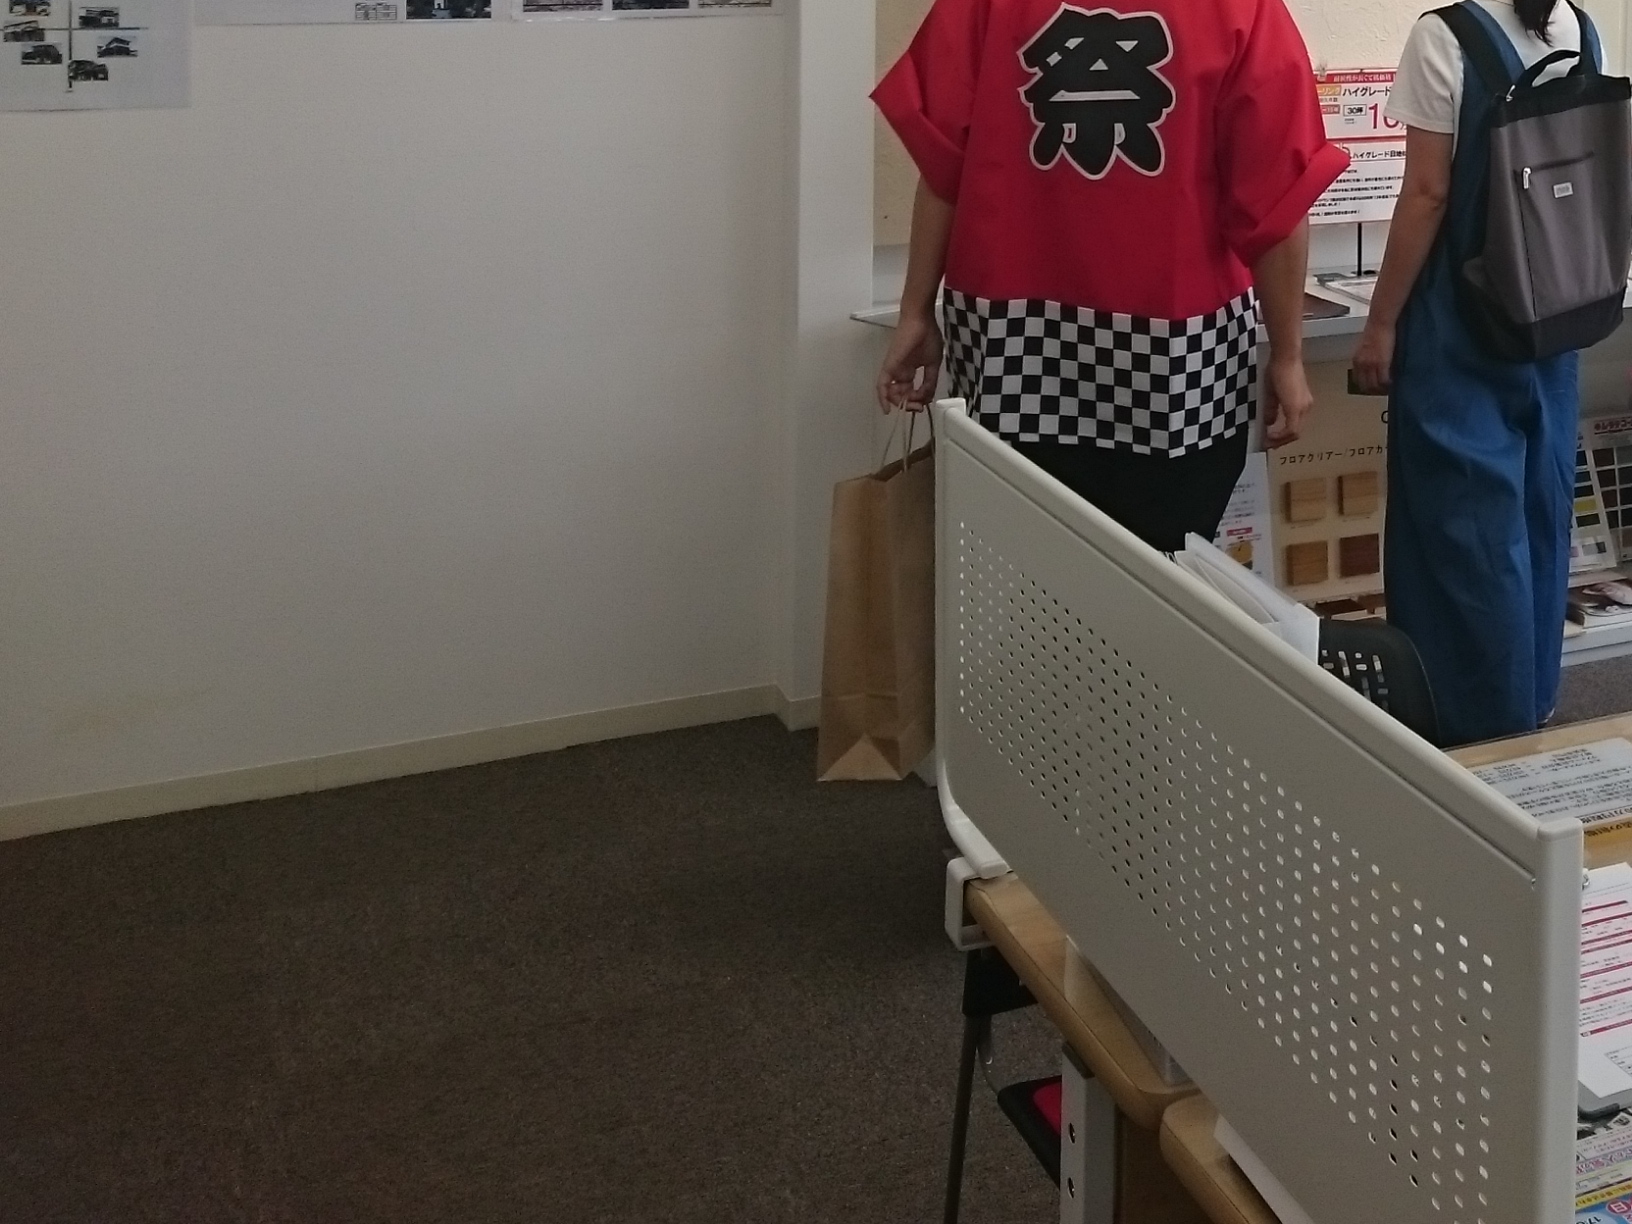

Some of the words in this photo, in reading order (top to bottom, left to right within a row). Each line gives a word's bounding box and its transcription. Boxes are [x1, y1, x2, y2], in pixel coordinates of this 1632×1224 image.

[1016, 2, 1176, 180] 祭
[1280, 444, 1387, 465] フロアクリアー/フロアカ
